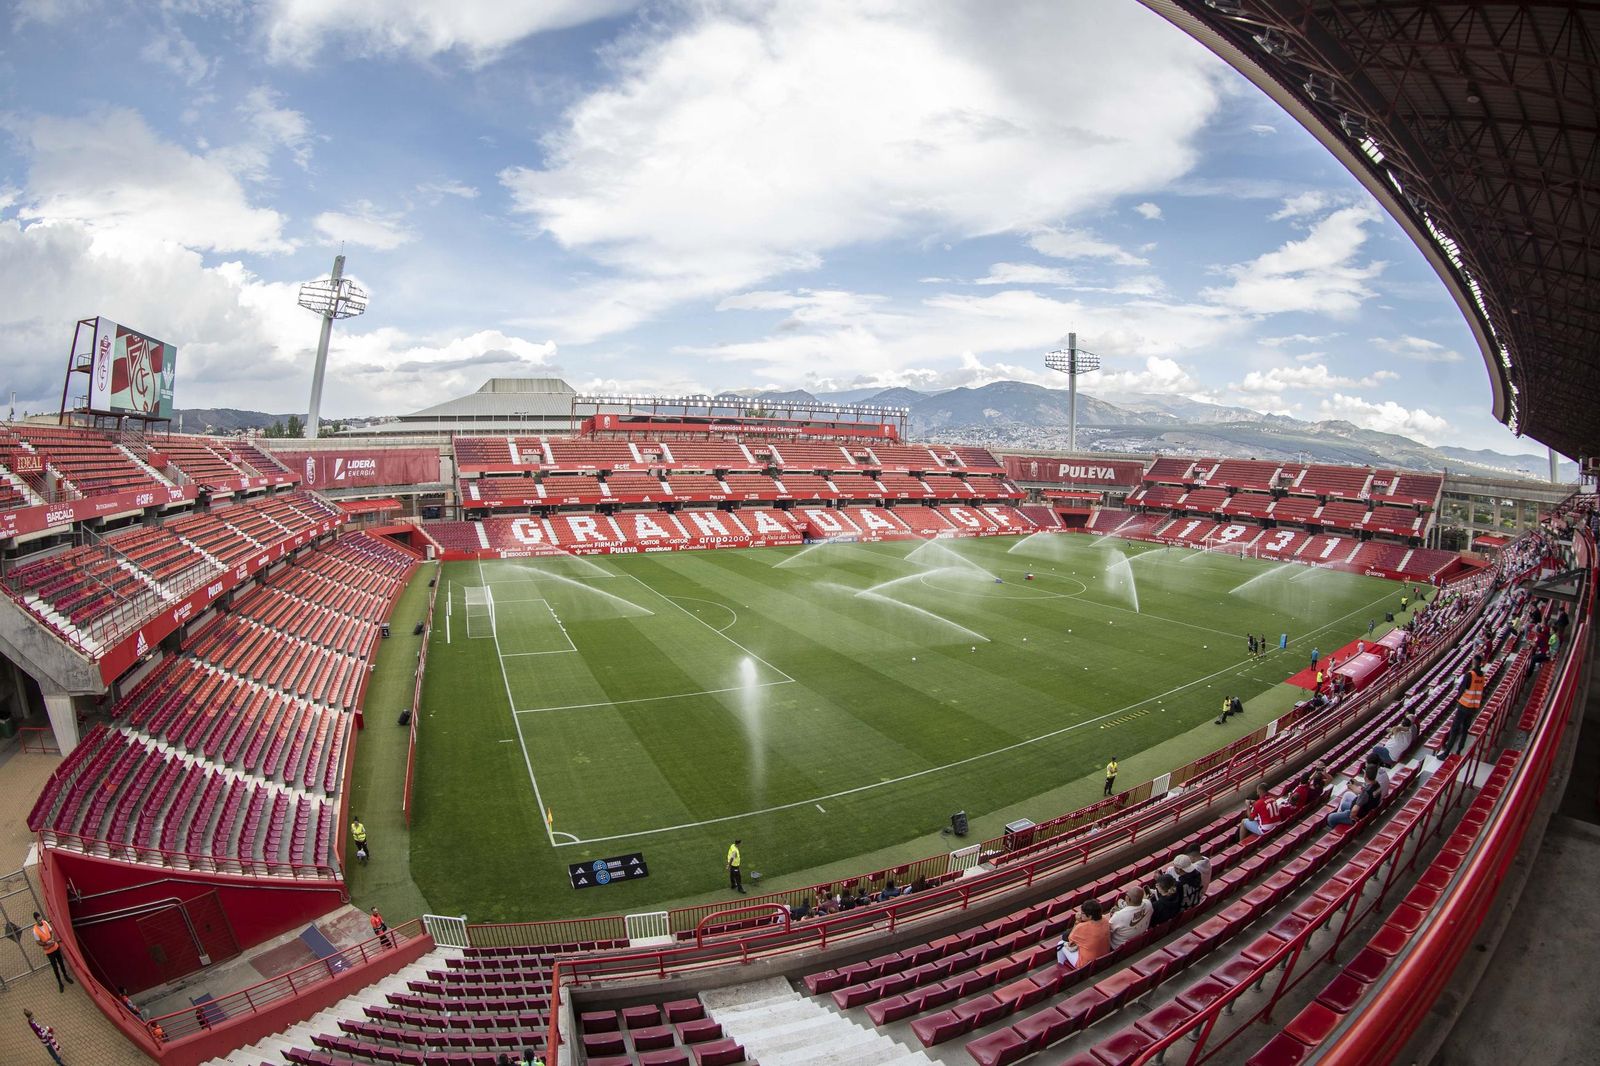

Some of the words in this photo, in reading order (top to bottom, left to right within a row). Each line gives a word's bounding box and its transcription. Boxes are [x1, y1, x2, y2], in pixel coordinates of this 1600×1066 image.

[16, 456, 43, 470] IDEAL
[347, 459, 376, 469] LIDERA
[348, 469, 375, 477] ENERGÍA
[1058, 464, 1116, 480] PULEVA
[49, 503, 70, 512] GRUPO
[46, 508, 74, 522] BARCALO
[1178, 520, 1341, 558] 1931
[1266, 801, 1280, 818] 10
